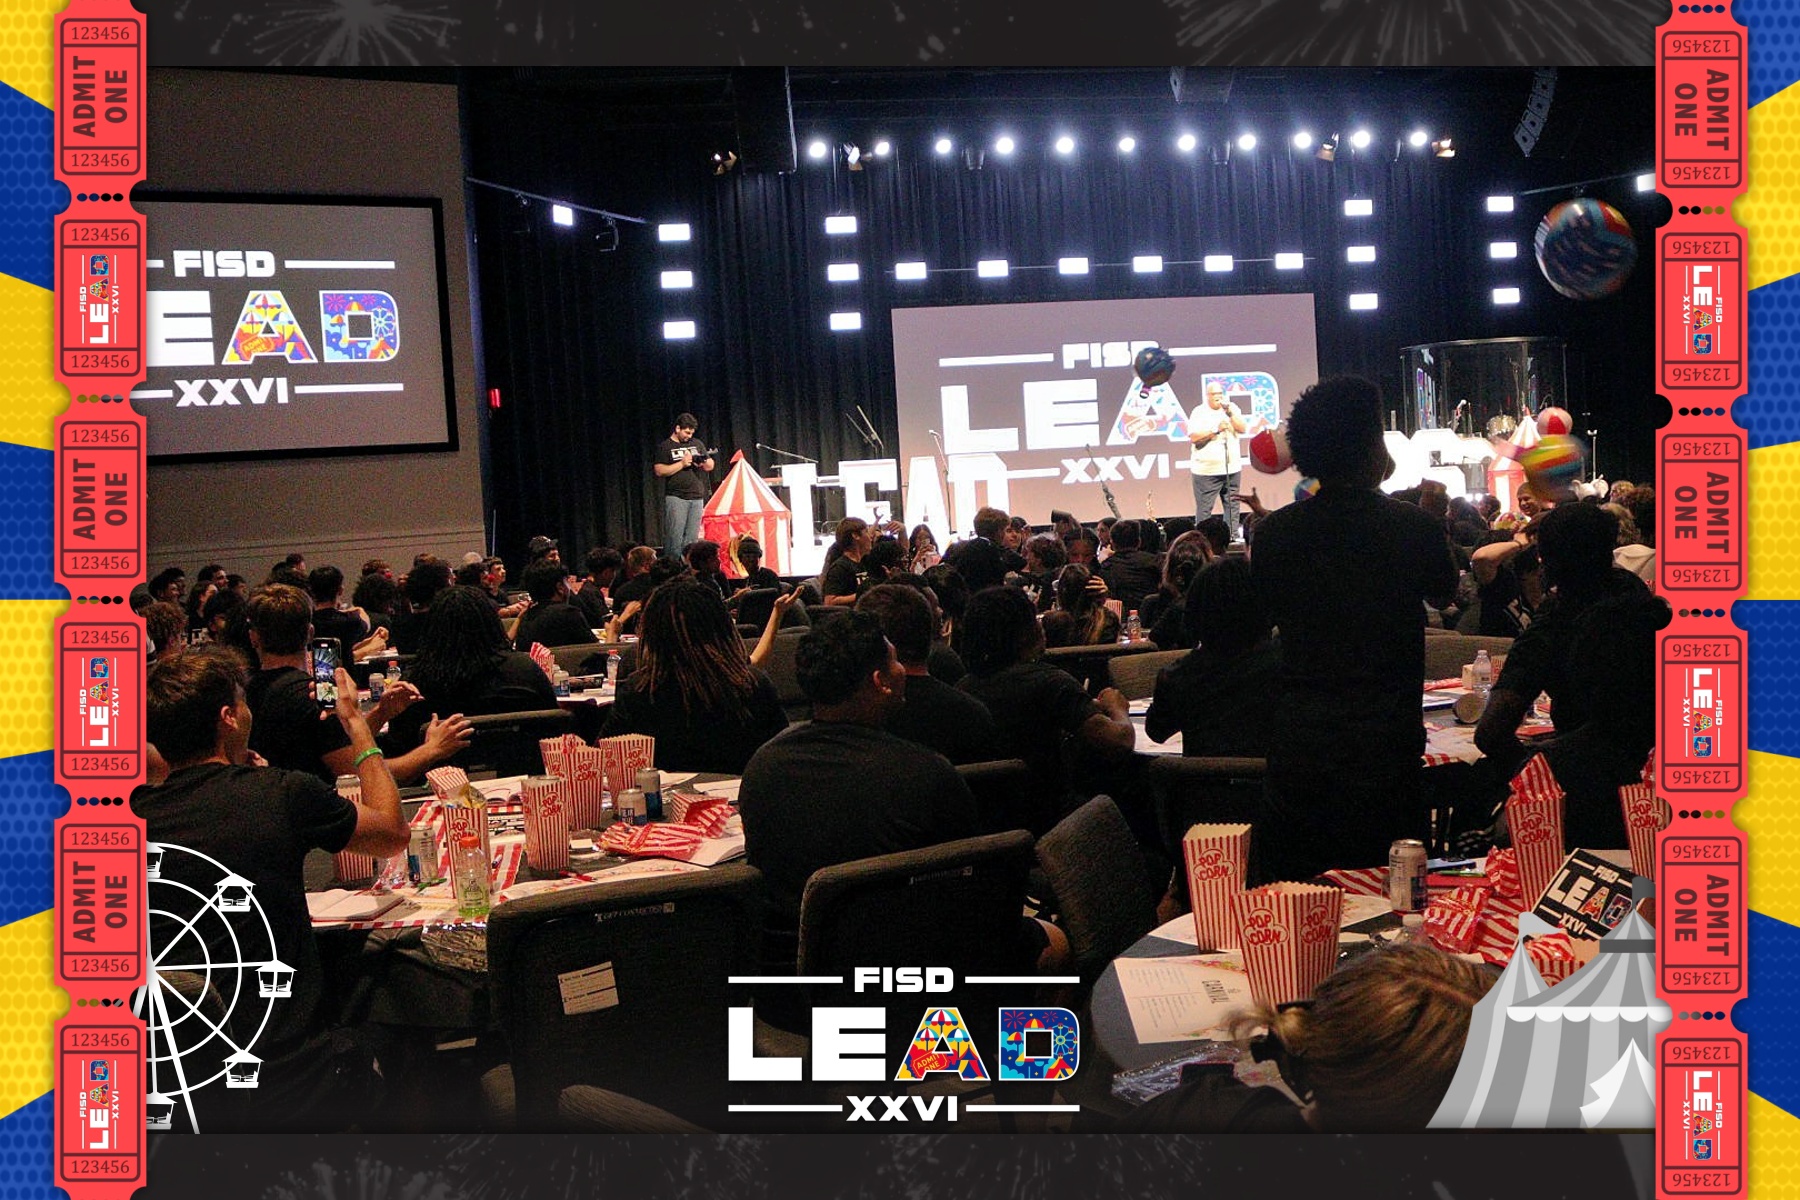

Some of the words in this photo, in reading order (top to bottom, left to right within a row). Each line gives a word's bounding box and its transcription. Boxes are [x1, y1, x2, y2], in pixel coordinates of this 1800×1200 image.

[173, 250, 275, 277] FISD
[146, 290, 400, 366] EAD
[174, 377, 289, 407] XXVI
[940, 371, 1281, 455] LEAD
[1061, 453, 1170, 484] XXVI
[577, 762, 593, 772] POP
[1633, 804, 1651, 815] POP
[452, 821, 468, 832] POP
[1522, 818, 1543, 831] POP
[1521, 829, 1551, 845] CORN
[1199, 853, 1221, 868] POP
[1199, 864, 1230, 881] CORN
[1546, 868, 1632, 930] LEAD
[1249, 914, 1272, 929] POP
[1306, 911, 1328, 926] POP
[1560, 912, 1588, 935] XXVI
[1249, 930, 1282, 946] CORN
[1305, 925, 1333, 943] CORN
